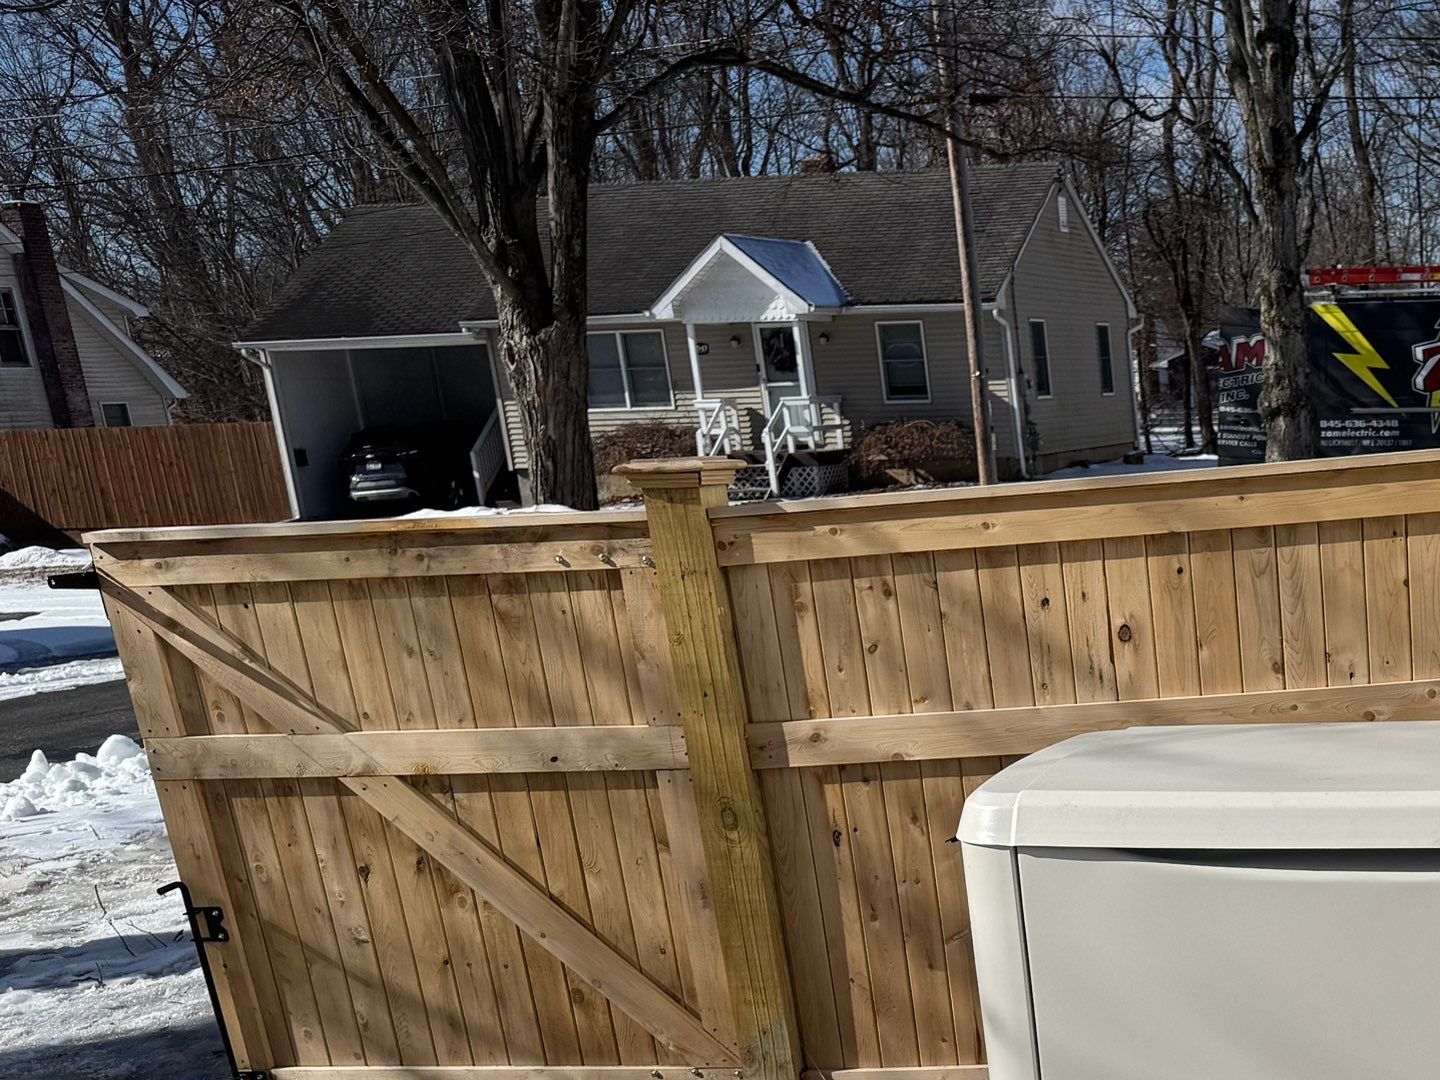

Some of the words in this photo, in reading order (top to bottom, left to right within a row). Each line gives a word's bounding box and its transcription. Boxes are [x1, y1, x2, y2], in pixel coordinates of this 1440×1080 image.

[1217, 333, 1266, 374] AM
[1220, 388, 1250, 404] INC.
[1320, 420, 1399, 428] 845-636-4348
[1320, 429, 1400, 437] zamelectric.com
